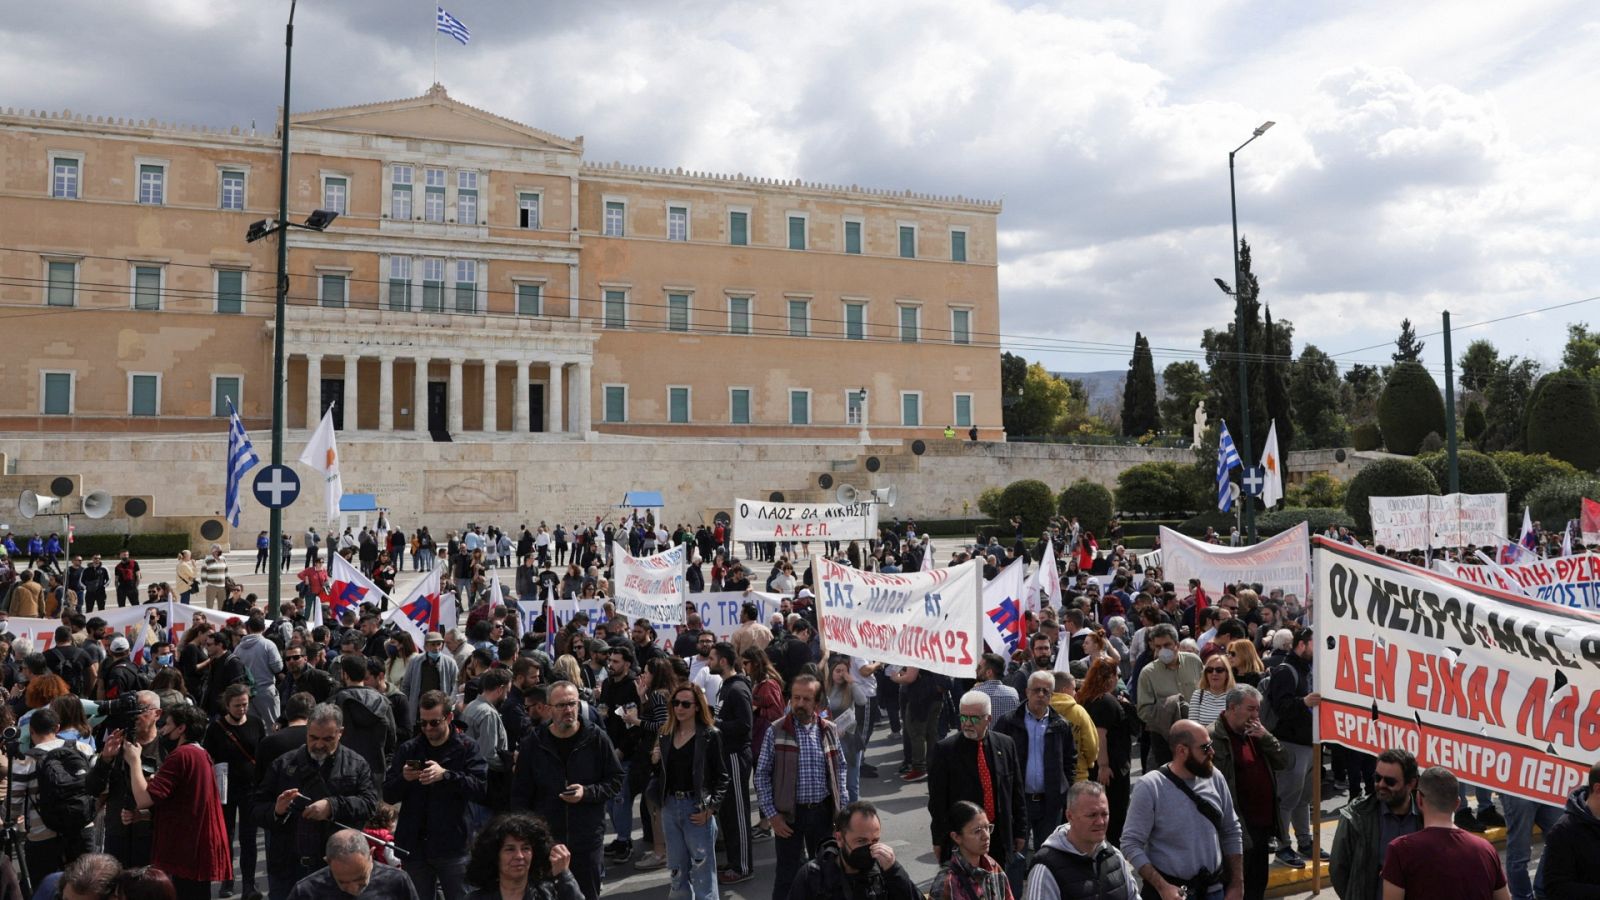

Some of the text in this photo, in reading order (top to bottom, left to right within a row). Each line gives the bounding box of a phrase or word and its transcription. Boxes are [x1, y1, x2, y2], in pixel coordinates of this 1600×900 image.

[740, 503, 749, 519] Ο
[758, 506, 795, 520] ΛΑΟΣ
[801, 507, 818, 520] ΘΑ
[718, 600, 765, 626] TRN
[1329, 563, 1359, 620] ΟΙ
[1363, 574, 1491, 648] ΝΕΚΡΟΙ
[1334, 635, 1398, 703] ΔΕΝ
[1407, 649, 1510, 729] ΕΙΝΑΙ
[1333, 710, 1421, 758] ΕΡΓΑΤΙΚΟ
[1426, 734, 1512, 783] ΚΕΝΤΡΟ
